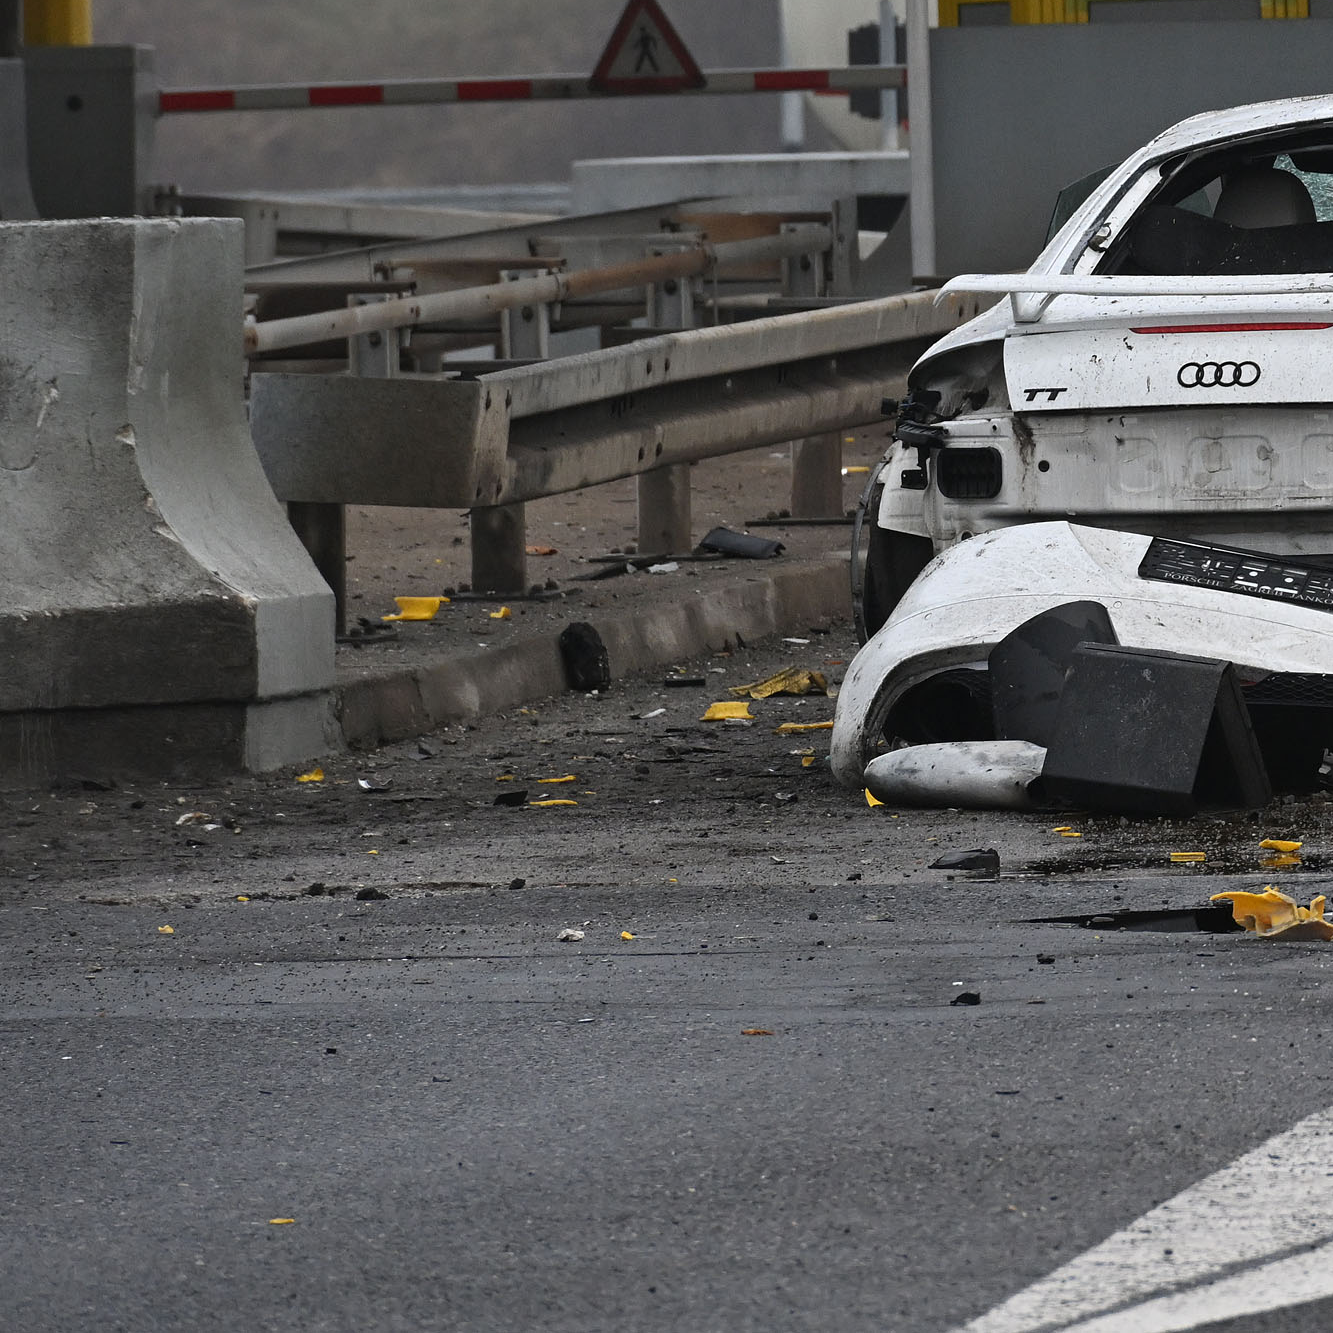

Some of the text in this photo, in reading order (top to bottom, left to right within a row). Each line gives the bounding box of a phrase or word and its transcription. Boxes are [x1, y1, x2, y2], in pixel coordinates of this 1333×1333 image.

[1024, 388, 1068, 402] TT
[1163, 571, 1225, 587] PORSCHE
[1229, 583, 1285, 597] ZAGREB
